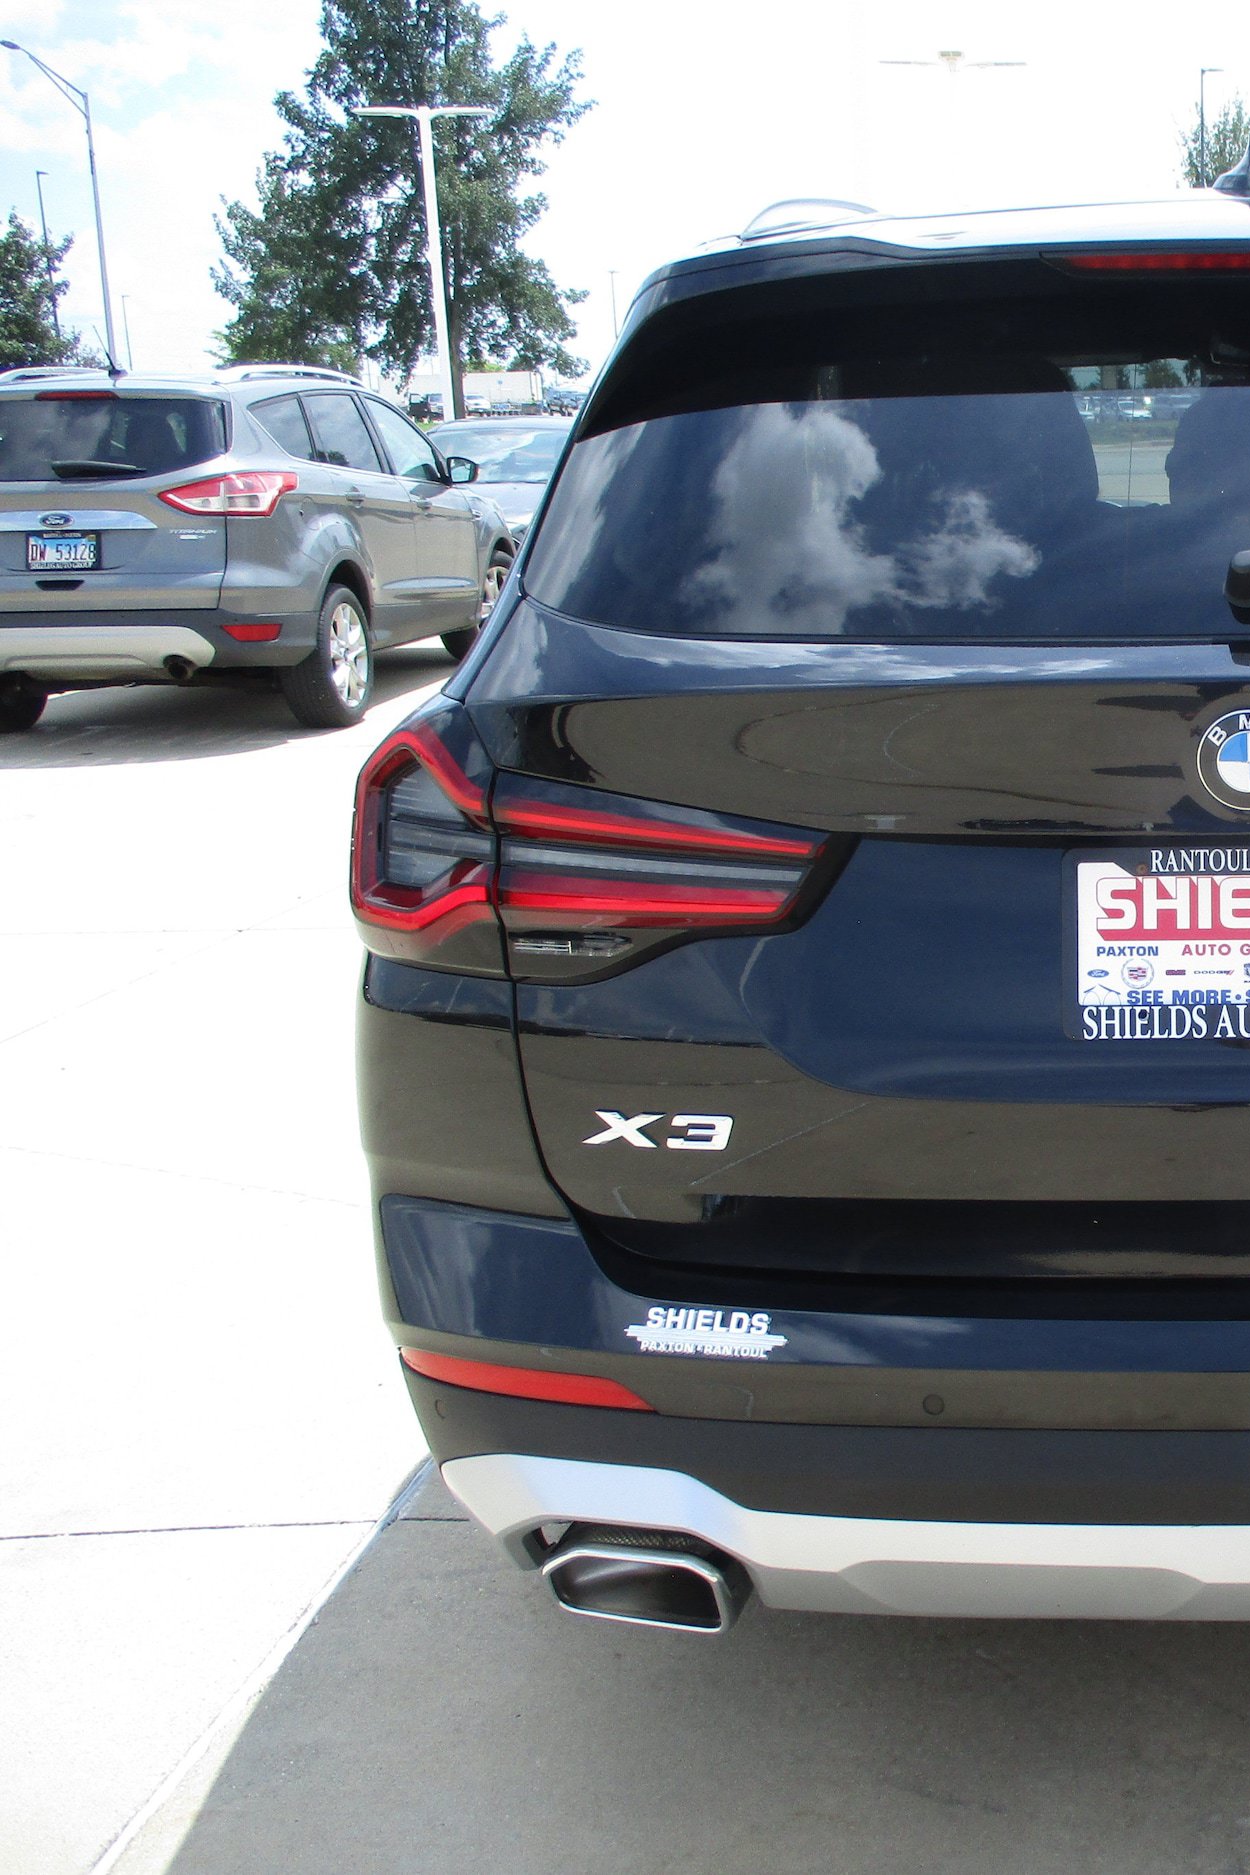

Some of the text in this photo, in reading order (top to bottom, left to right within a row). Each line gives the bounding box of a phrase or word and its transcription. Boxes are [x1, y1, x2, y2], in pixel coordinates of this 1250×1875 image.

[31, 543, 96, 561] DW 53128
[1096, 945, 1159, 956] PAXTON
[1181, 943, 1232, 956] AUTO
[1127, 989, 1164, 1005] SEE
[1171, 989, 1231, 1004] MORE
[1082, 1004, 1208, 1040] SHIELDS
[581, 1110, 733, 1151] X3
[646, 1306, 771, 1336] SHIELDS
[640, 1339, 769, 1359] PAXTON RANTOUL
